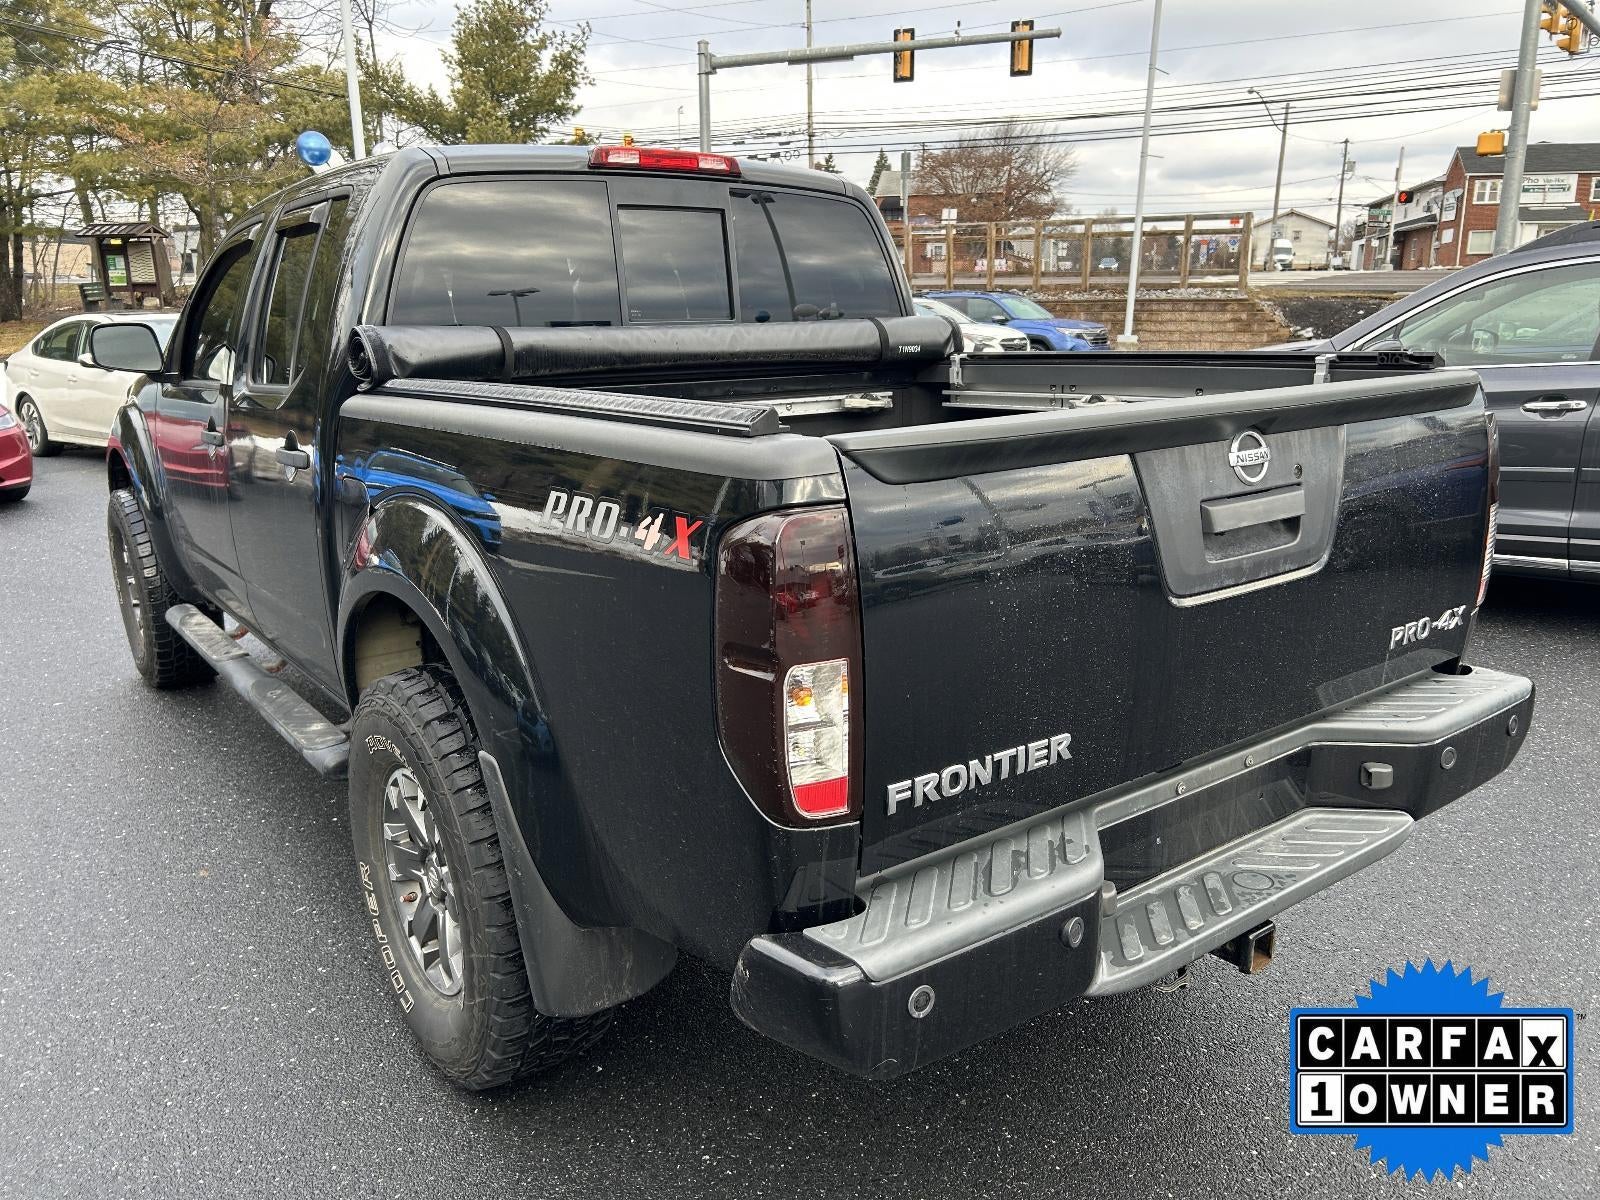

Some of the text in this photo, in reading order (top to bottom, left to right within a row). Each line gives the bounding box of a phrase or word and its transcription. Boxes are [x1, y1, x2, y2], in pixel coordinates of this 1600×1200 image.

[1236, 450, 1270, 464] NISSAN
[540, 488, 704, 562] PRO-4X
[1390, 604, 1467, 650] PRO-4X
[886, 731, 1073, 816] FRONTIER
[359, 861, 415, 1014] COOPER
